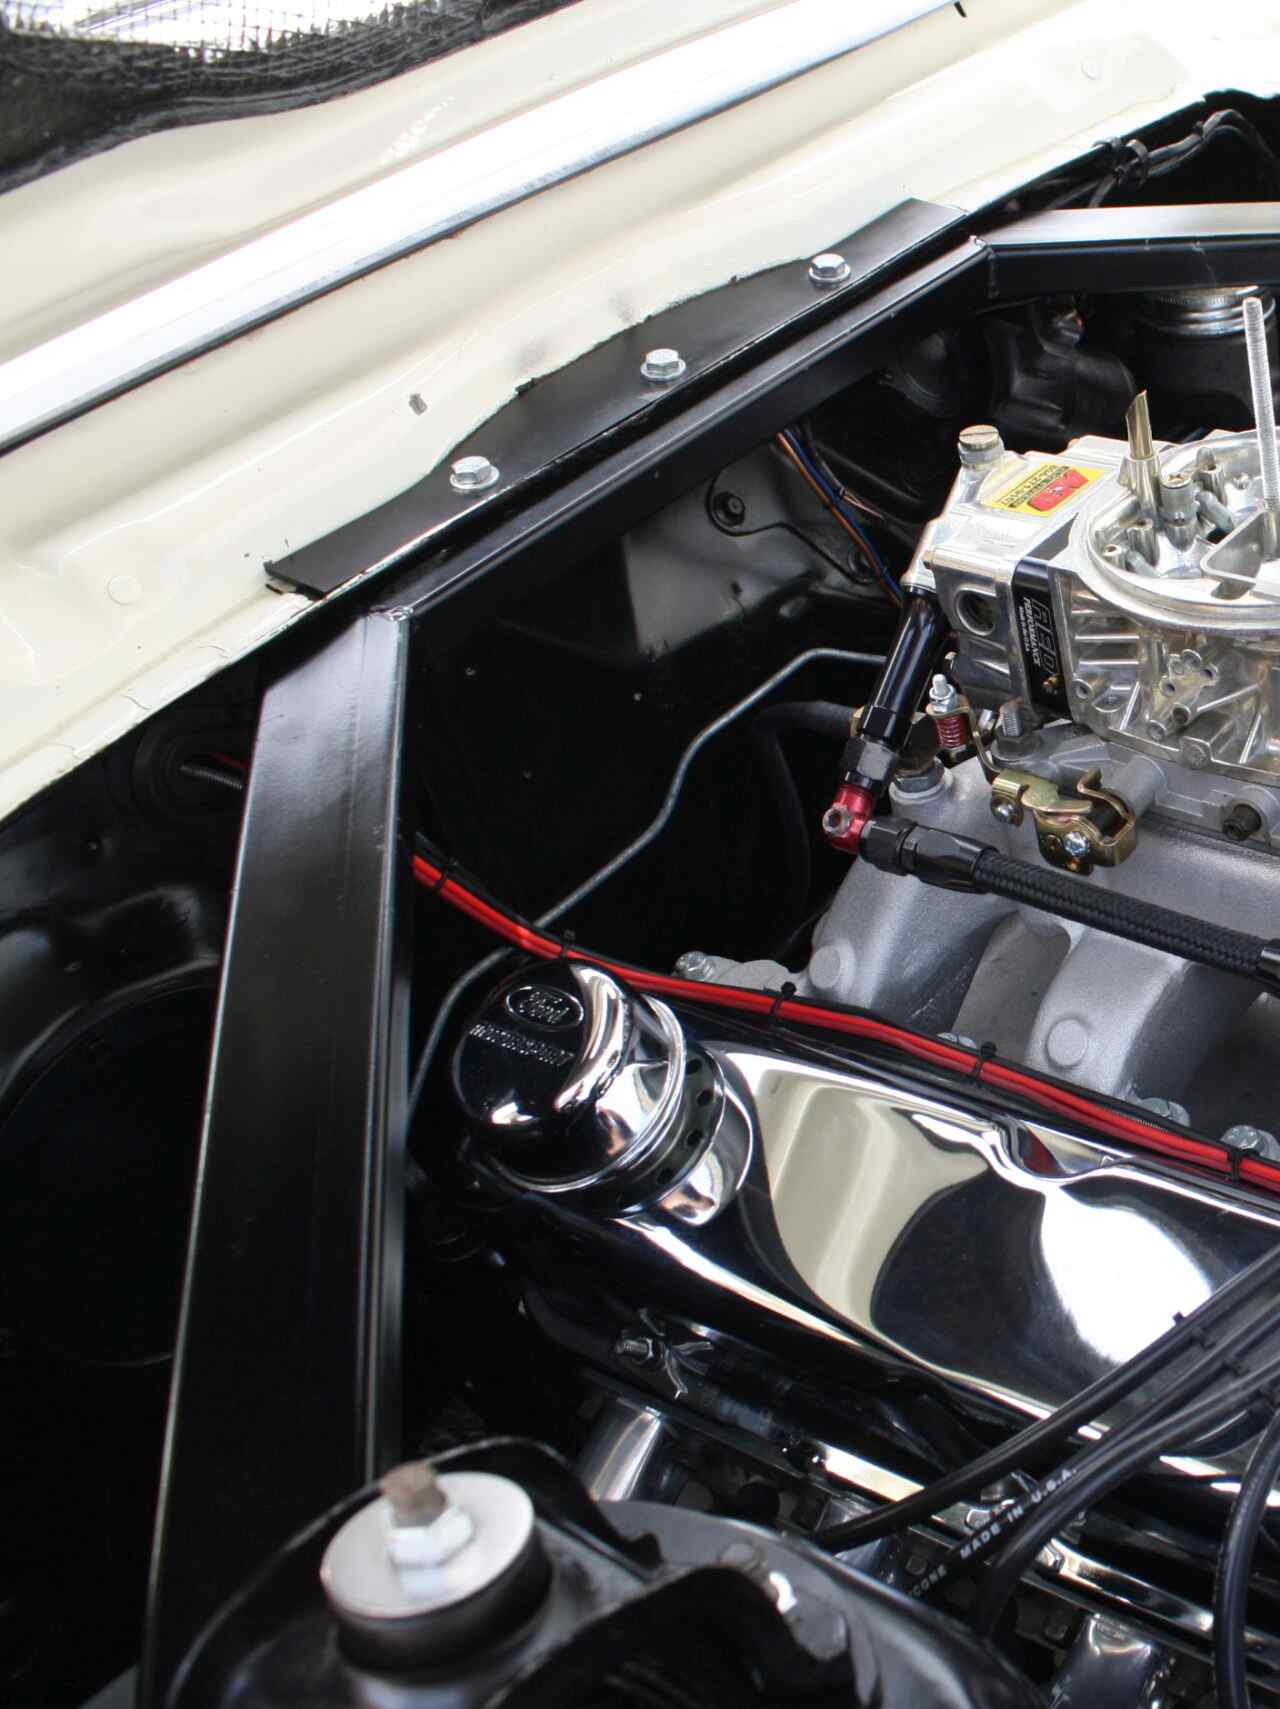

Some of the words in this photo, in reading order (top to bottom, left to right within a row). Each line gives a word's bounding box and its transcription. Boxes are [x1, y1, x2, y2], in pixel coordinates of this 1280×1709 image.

[1023, 596, 1041, 667] PERFORMANCE
[959, 1522, 1001, 1560] MADE
[1006, 1504, 1025, 1523] IN
[1031, 1468, 1078, 1504] U.S.A.
